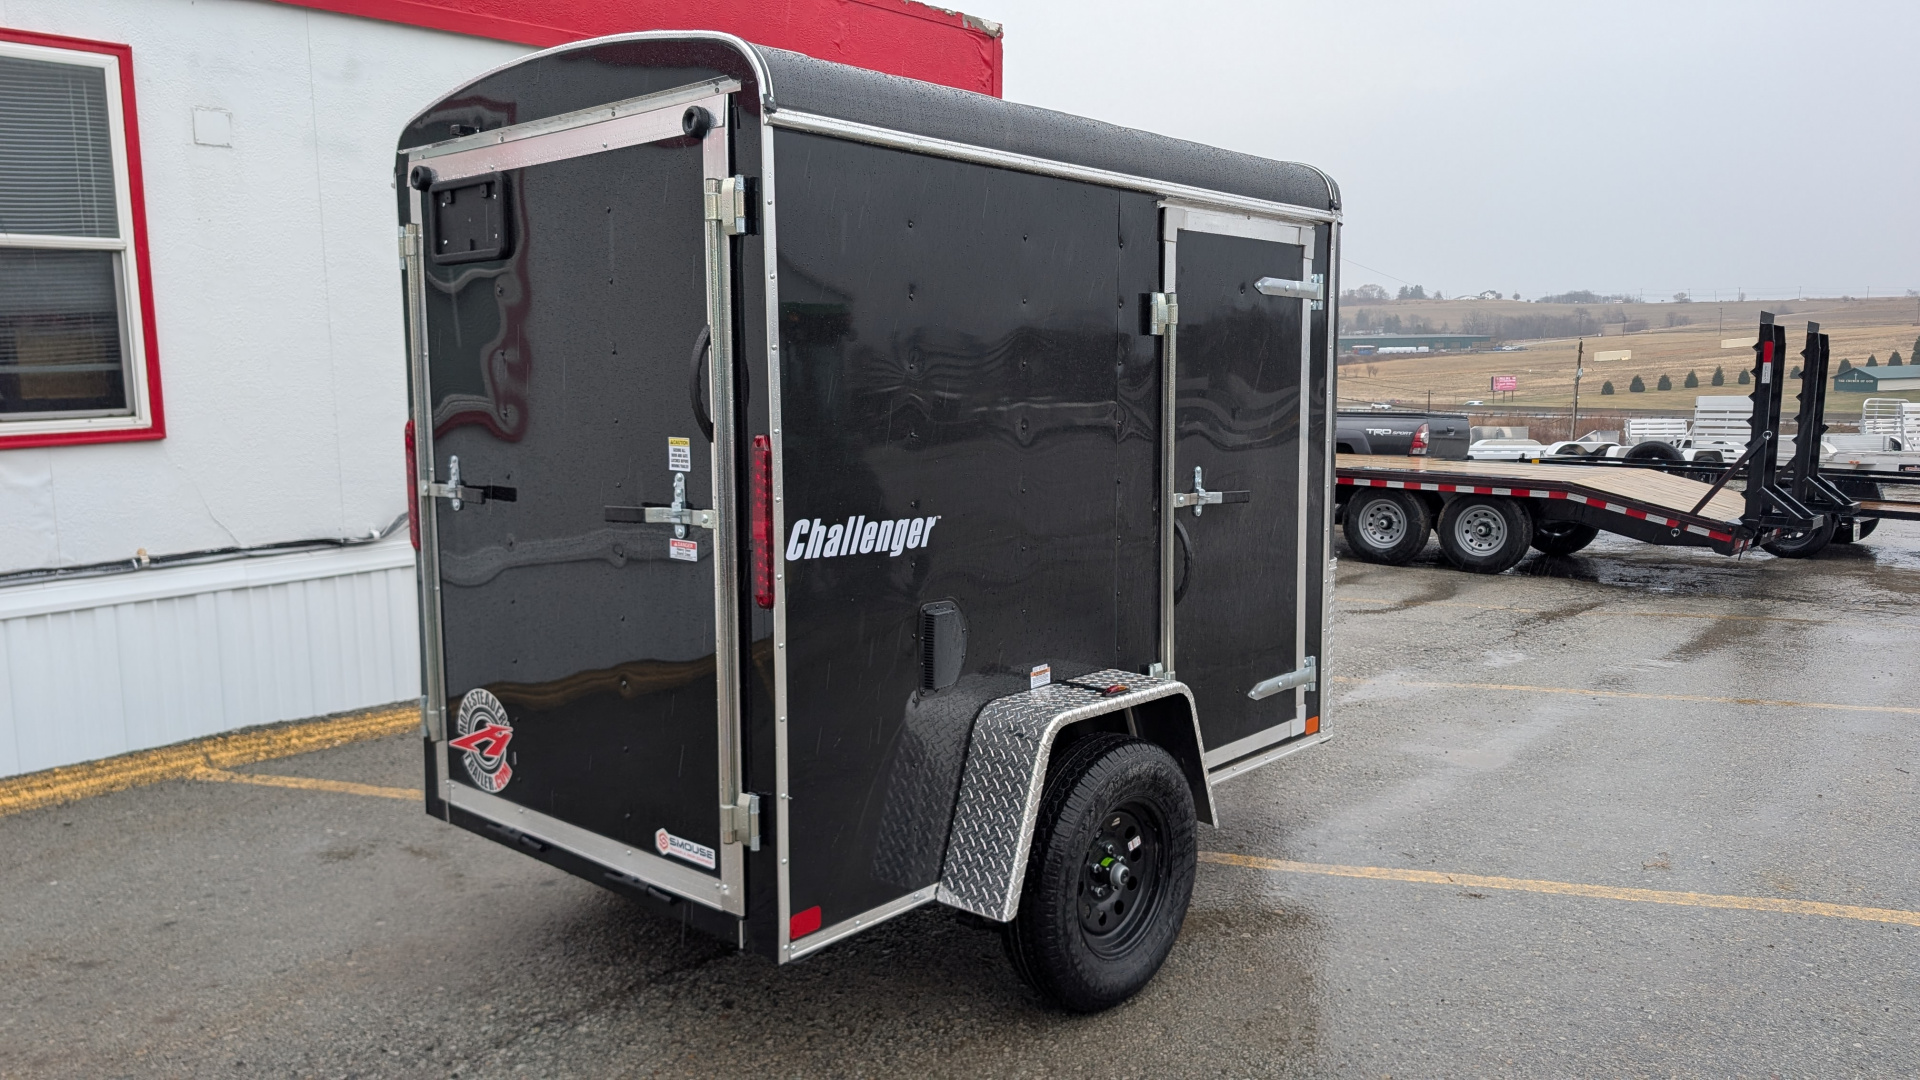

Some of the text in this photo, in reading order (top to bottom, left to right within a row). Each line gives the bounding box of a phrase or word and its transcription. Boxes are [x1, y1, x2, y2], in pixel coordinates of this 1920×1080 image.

[1366, 428, 1391, 436] TRD
[677, 541, 693, 549] DANGER
[785, 515, 936, 561] Challenger
[459, 690, 509, 736] HOMESTEADER
[669, 837, 713, 860] SMOUSE
